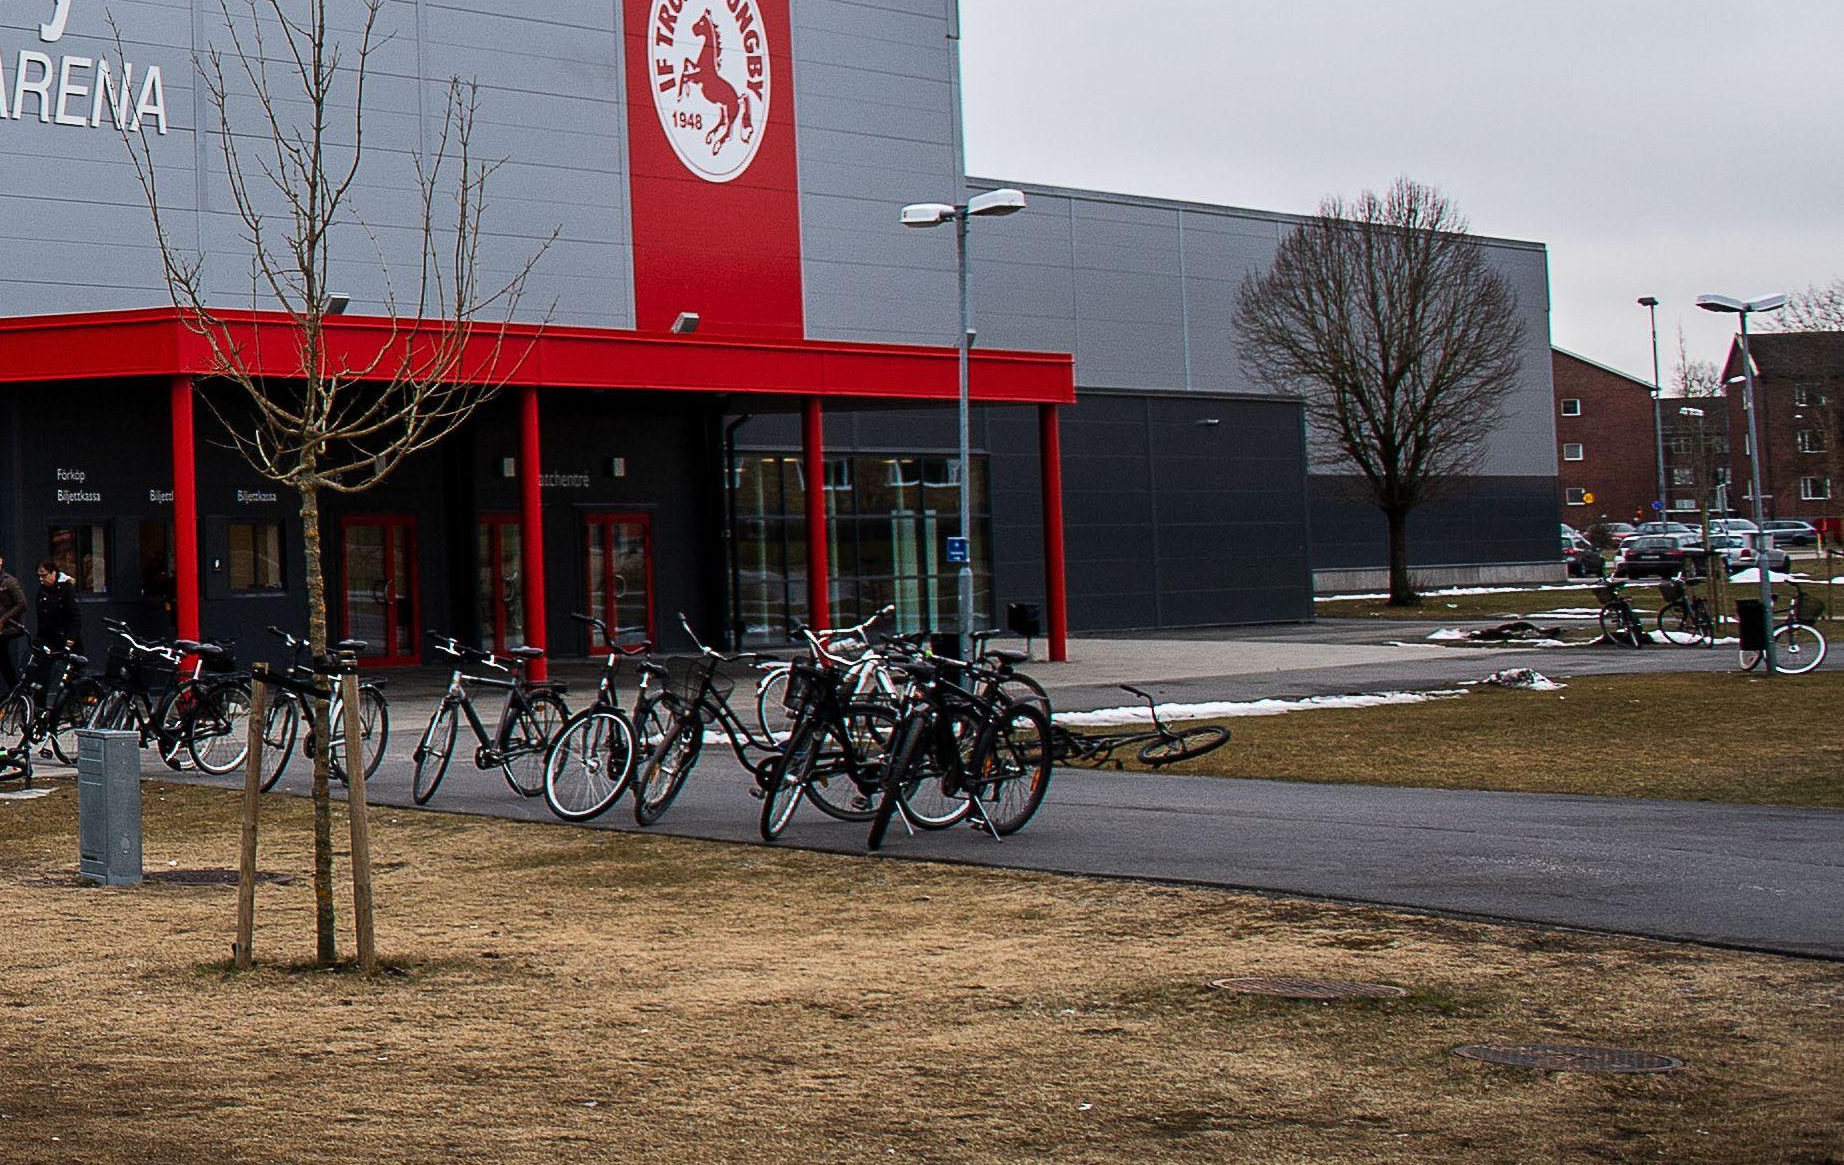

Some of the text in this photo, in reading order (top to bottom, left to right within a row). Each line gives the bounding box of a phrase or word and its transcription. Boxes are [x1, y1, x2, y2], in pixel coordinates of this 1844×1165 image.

[656, 59, 676, 92] IF
[672, 111, 702, 130] 1948
[539, 469, 590, 487] atchentré
[57, 489, 101, 504] Biljettkassa
[149, 489, 174, 504] Biljett
[237, 489, 277, 504] Biljettkassa
